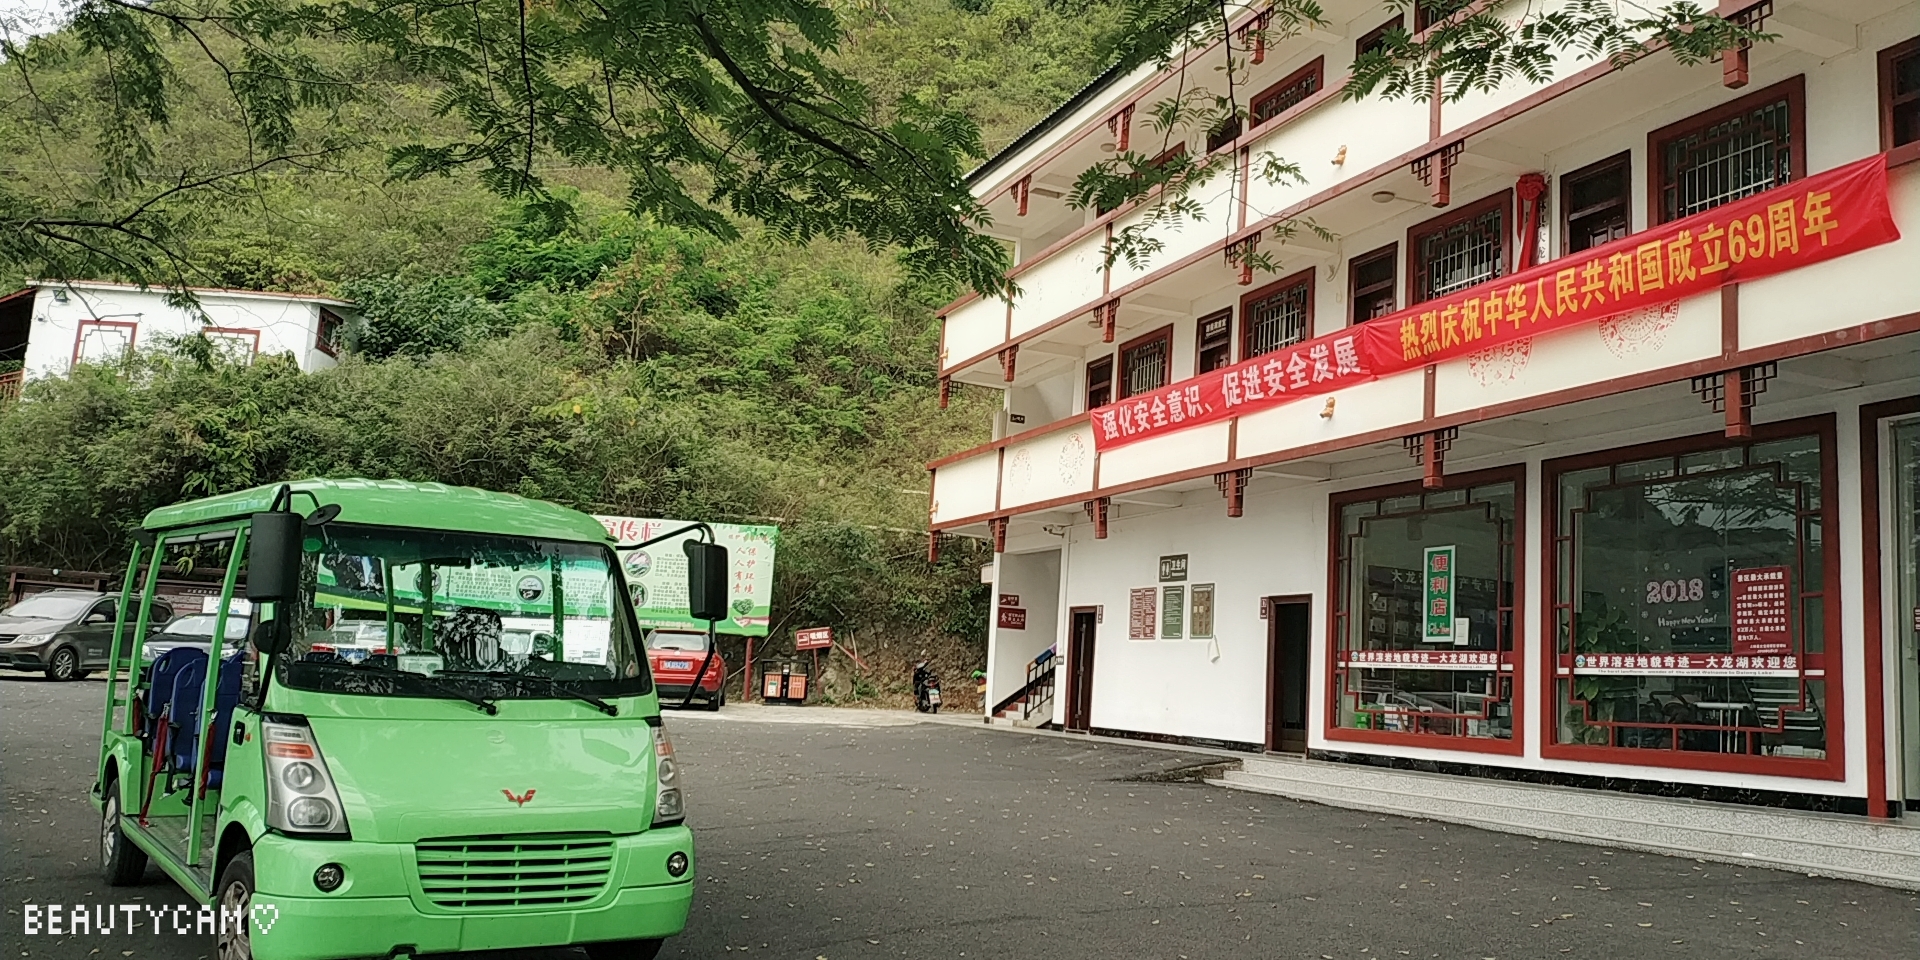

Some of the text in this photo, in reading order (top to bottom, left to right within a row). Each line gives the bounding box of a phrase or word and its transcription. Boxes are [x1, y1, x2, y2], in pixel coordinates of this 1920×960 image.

[1400, 189, 1838, 361] 热烈庆祝中华人民共和国成立69周年
[1102, 336, 1361, 441] 强化安全意识、促进安全发展
[1430, 554, 1449, 616] 便利店
[1646, 578, 1704, 604] 2018
[1681, 616, 1696, 625] New
